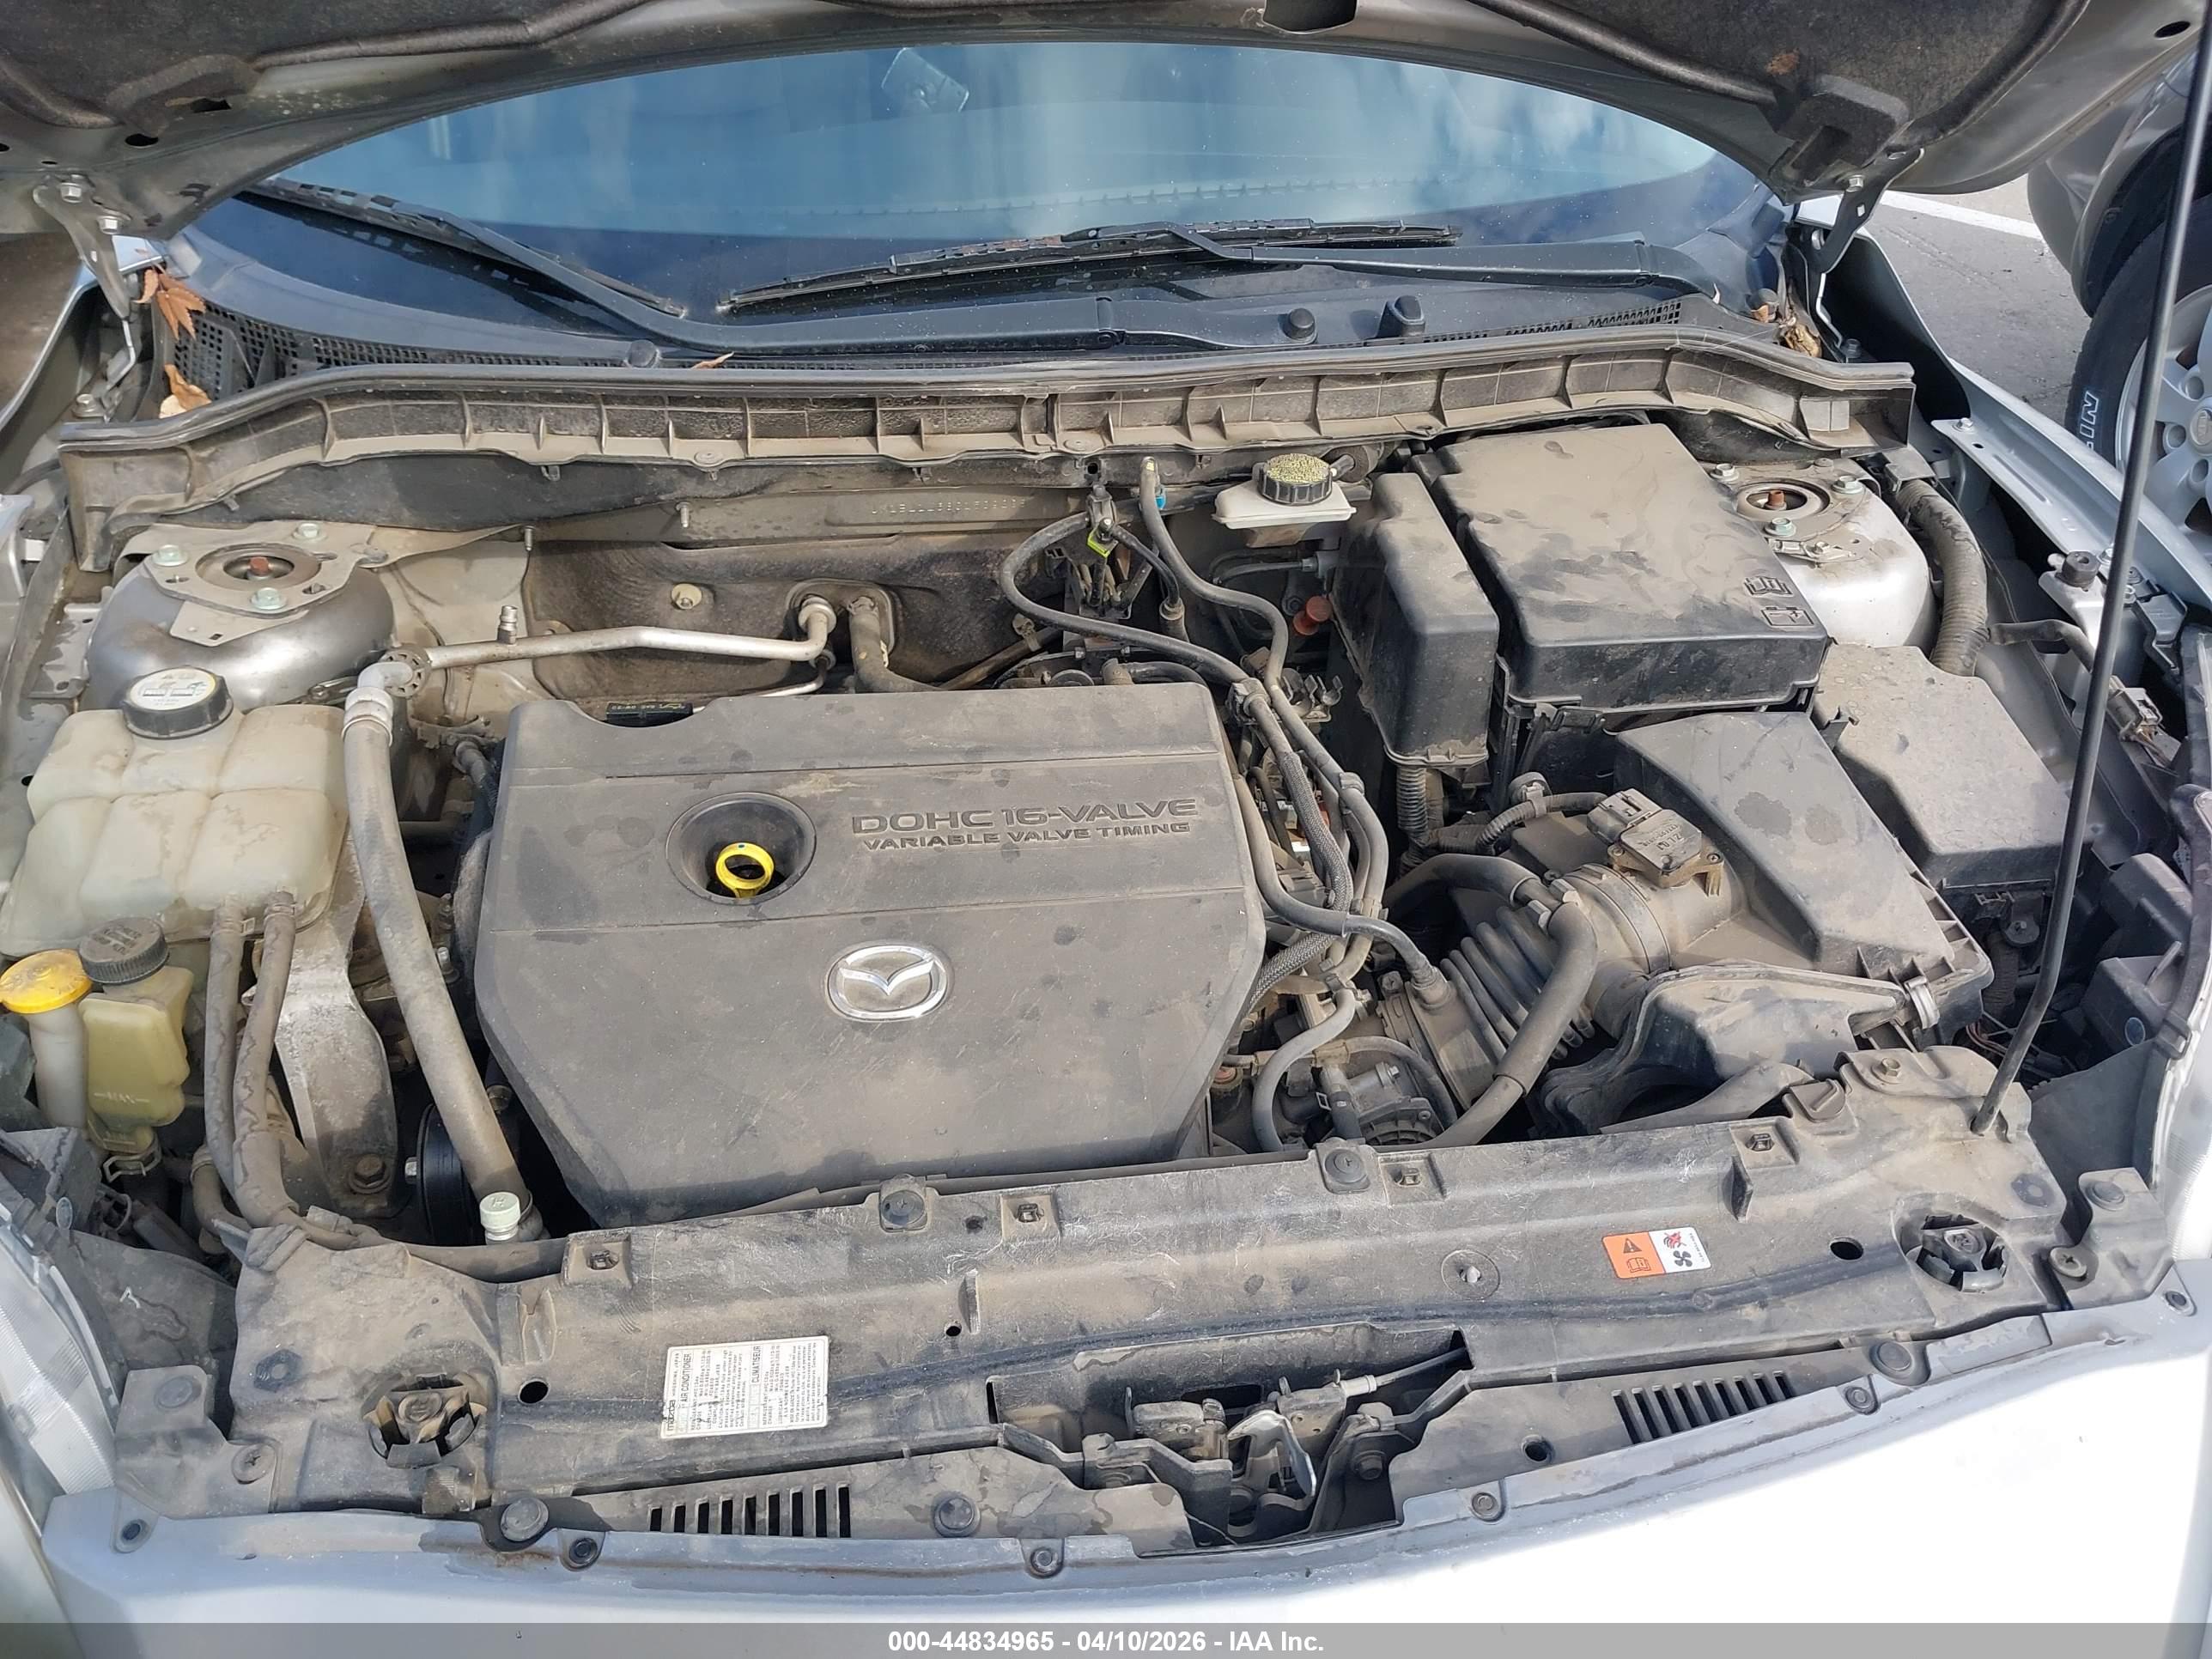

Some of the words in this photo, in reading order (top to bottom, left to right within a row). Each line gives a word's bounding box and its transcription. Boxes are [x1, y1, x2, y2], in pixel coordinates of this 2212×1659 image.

[853, 810, 993, 834] DOHC
[1002, 799, 1200, 825] 16-VALVE
[863, 833, 1000, 851] VARIABLE
[1008, 828, 1090, 842] VALVE
[1097, 822, 1191, 837] TIMING
[680, 1352, 691, 1391] CONDITIONER
[751, 1346, 761, 1382] CLIMATISEUR
[666, 1400, 676, 1431] mazda
